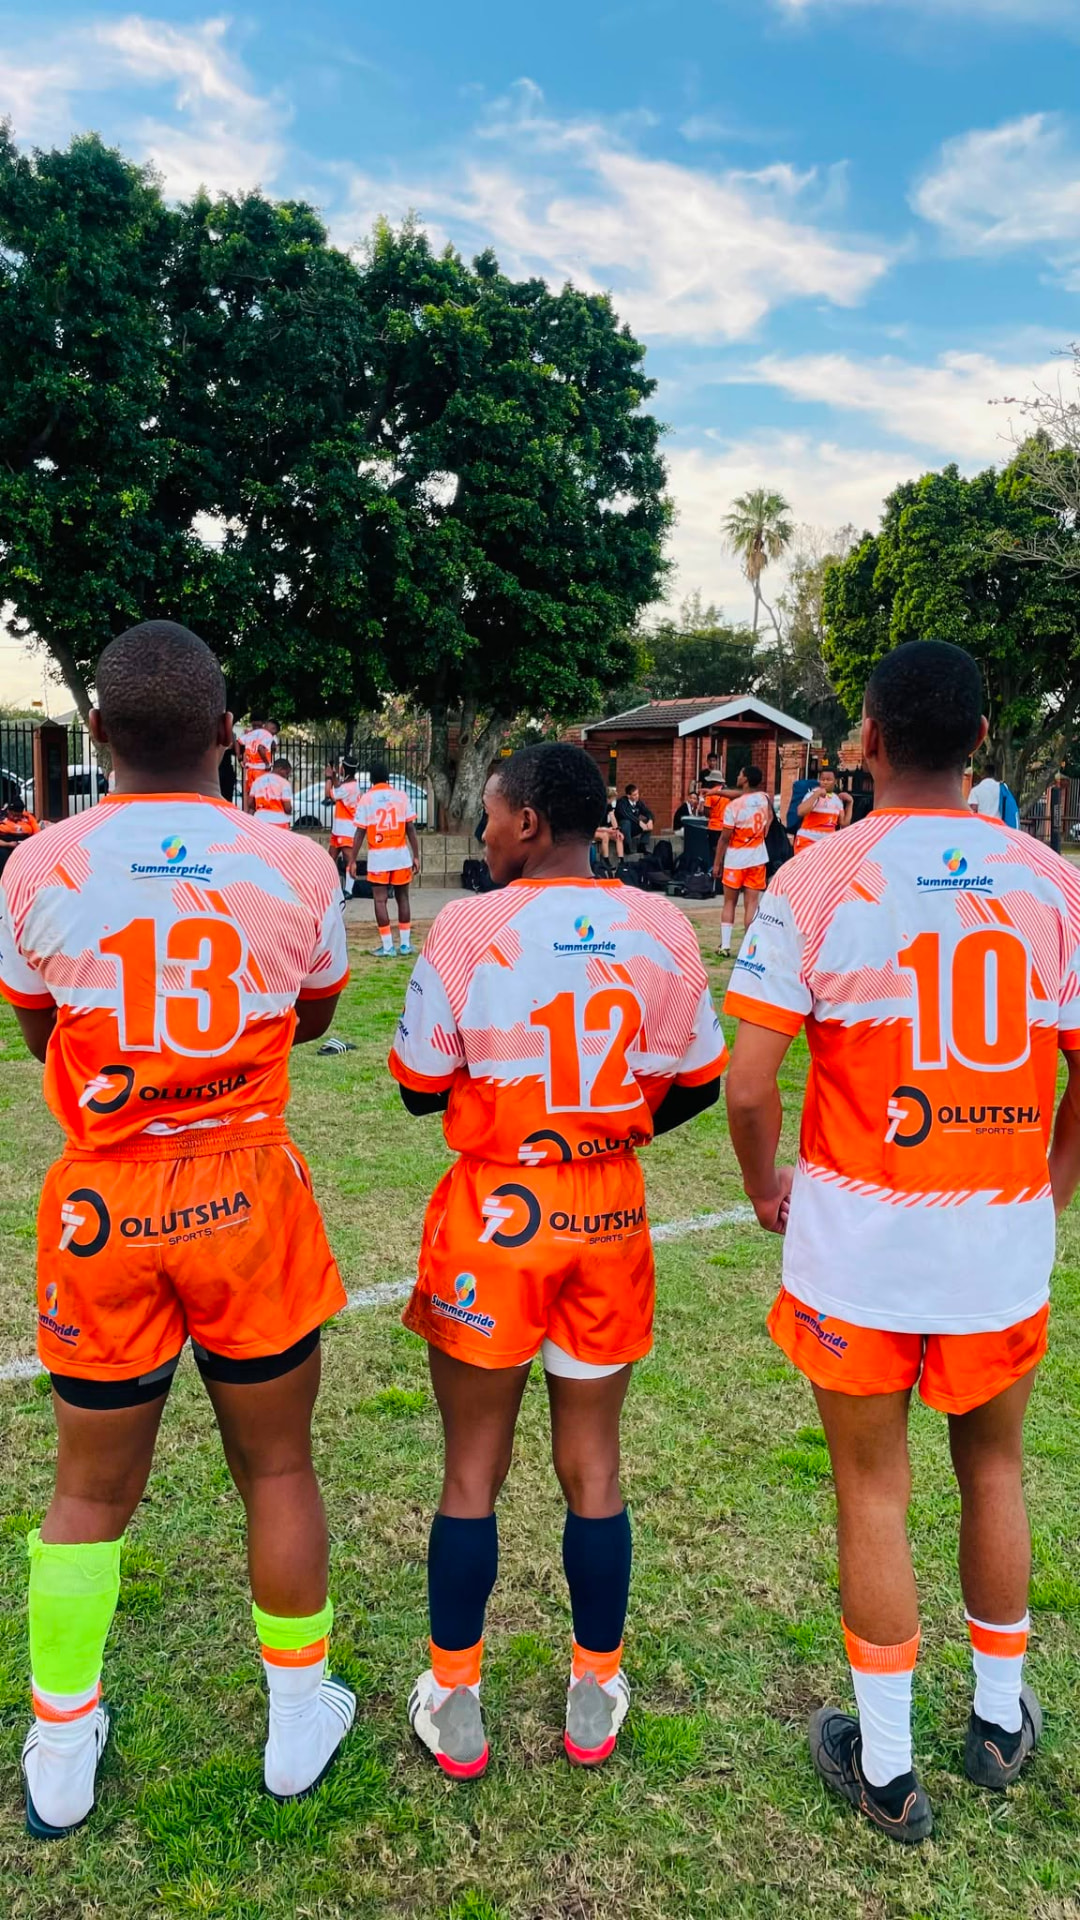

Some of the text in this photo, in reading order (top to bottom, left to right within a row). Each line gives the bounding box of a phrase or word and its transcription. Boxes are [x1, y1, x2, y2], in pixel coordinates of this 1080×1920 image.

[375, 807, 397, 830] 21
[130, 863, 213, 876] Summerpride
[916, 876, 993, 888] Summerpride
[553, 941, 616, 953] Summerpride
[99, 914, 247, 1056] 13
[897, 926, 1032, 1071] 10
[529, 985, 645, 1113] 12
[139, 1074, 248, 1100] OLUTSHA
[975, 1127, 1014, 1135] SPORTS
[120, 1191, 251, 1237] OLUTSHA
[168, 1228, 212, 1245] SPORTS
[589, 1234, 623, 1245] SPORTS
[432, 1294, 494, 1328] Summerpride
